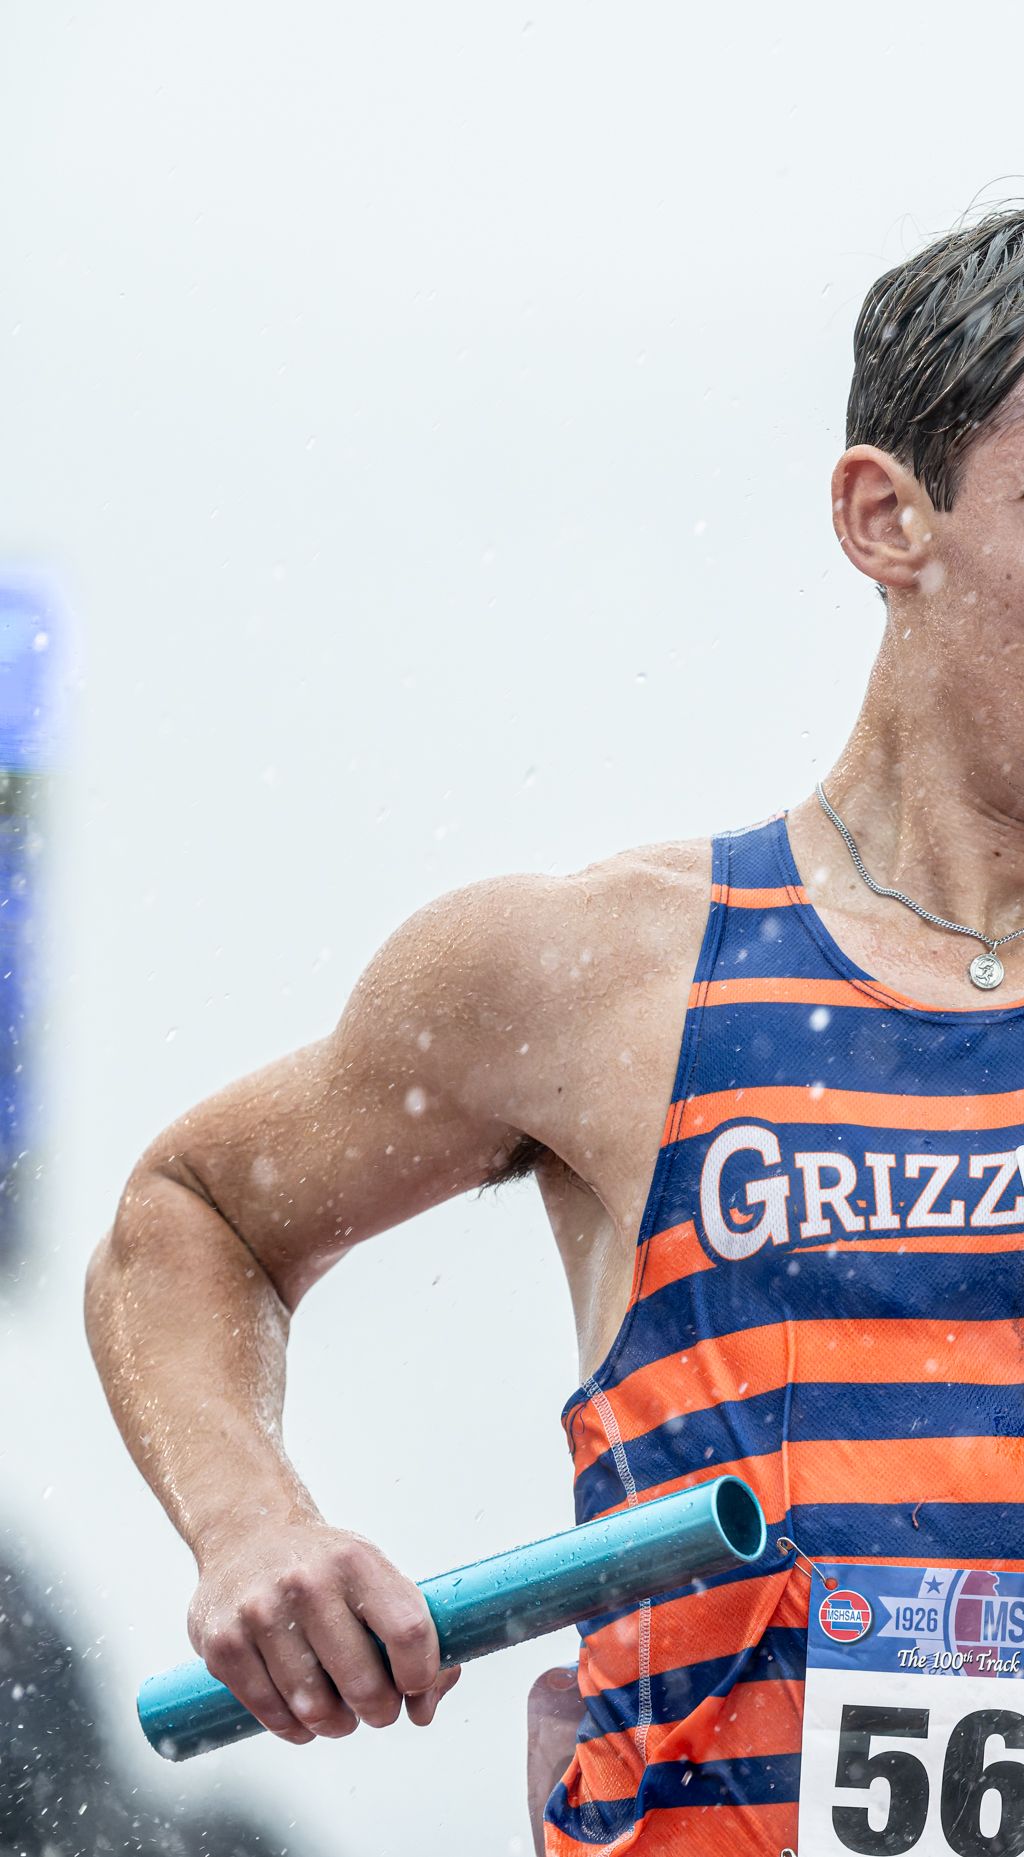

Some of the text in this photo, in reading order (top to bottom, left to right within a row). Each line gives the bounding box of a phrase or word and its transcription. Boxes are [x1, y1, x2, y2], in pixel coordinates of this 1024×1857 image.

[827, 1609, 861, 1622] MSHSAA
[895, 1606, 939, 1633] 1926
[897, 1647, 927, 1669] The
[931, 1650, 973, 1671] 100th
[975, 1650, 1020, 1674] Track
